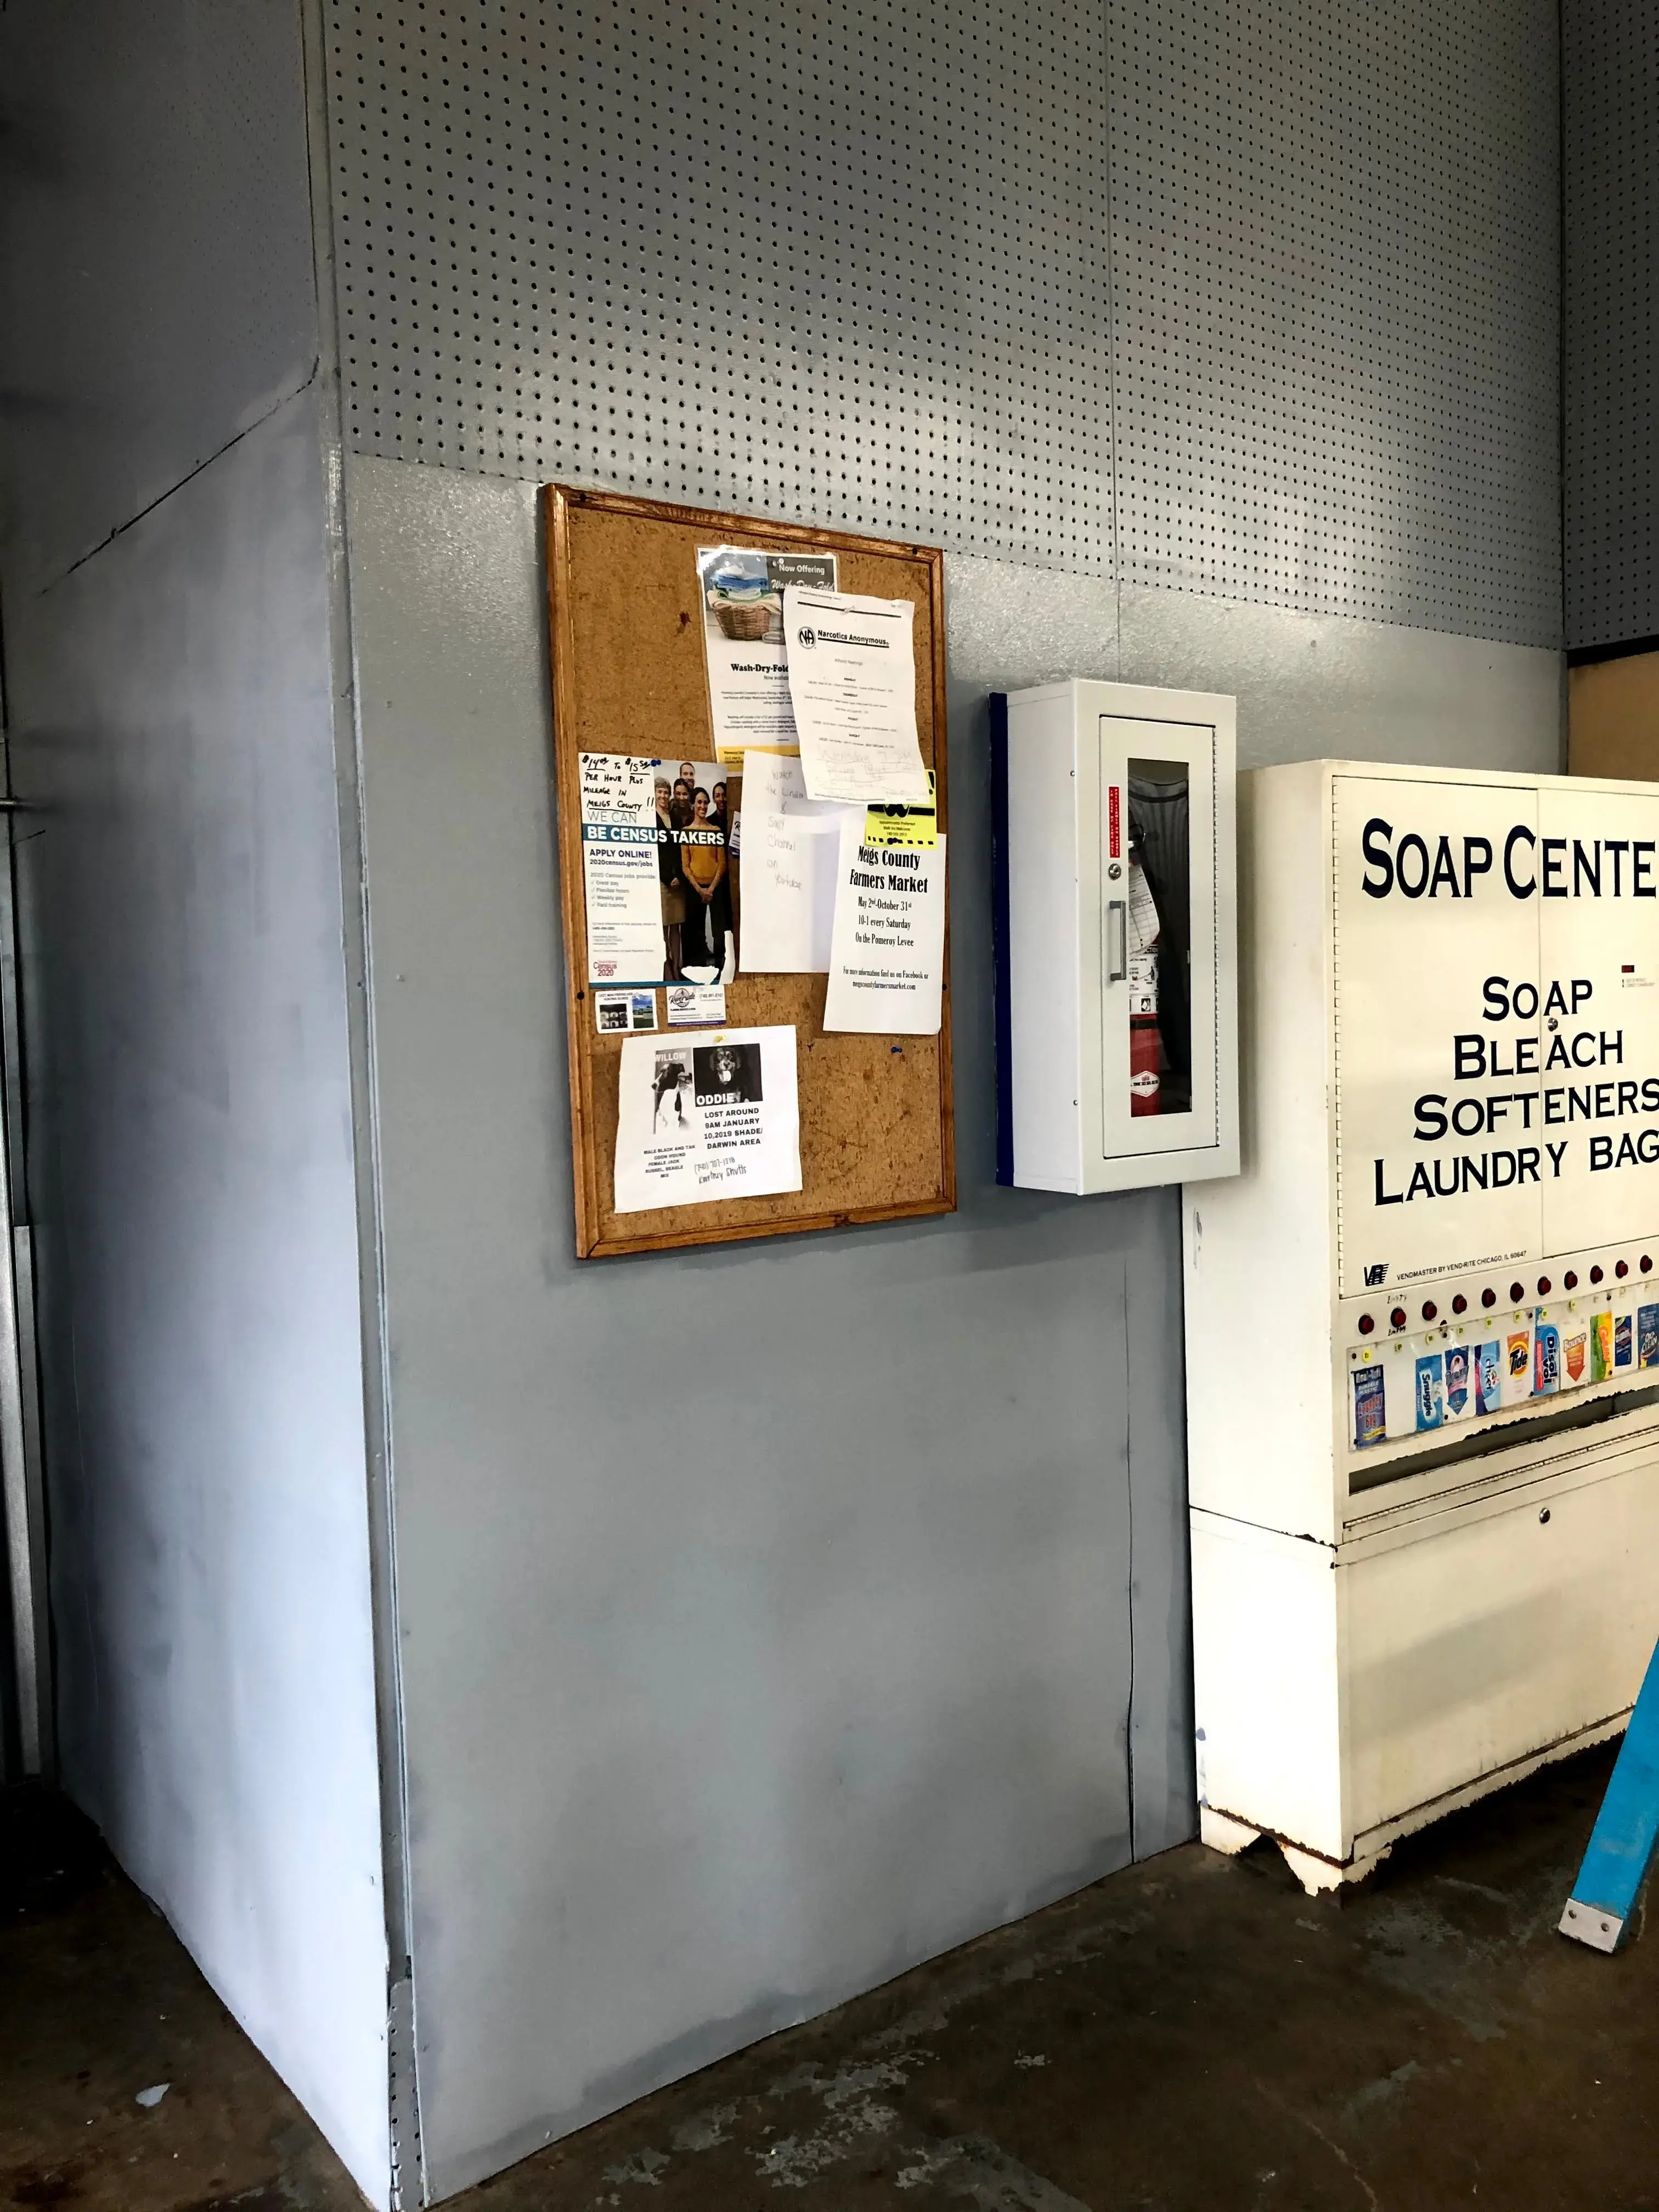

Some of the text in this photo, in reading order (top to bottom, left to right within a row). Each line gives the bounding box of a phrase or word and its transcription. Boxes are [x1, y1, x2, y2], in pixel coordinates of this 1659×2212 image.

[797, 565, 825, 575] Offering
[818, 630, 847, 640] Narcotics
[585, 772, 598, 783] PER
[588, 811, 637, 823] WE CAN
[587, 826, 725, 845] BE CENSUS TAKERS
[590, 849, 652, 859] APPLY ONLINE!
[857, 845, 921, 870] Meigs County
[590, 859, 653, 867] 2020census.gov/jobs
[850, 869, 928, 893] Farmers Market
[858, 896, 867, 909] May
[900, 901, 912, 911] 31st
[858, 915, 911, 930] 10-1 every Saturday
[855, 932, 862, 943] On
[871, 934, 895, 947] Pomeroy
[898, 936, 914, 946] Levee
[859, 968, 879, 977] information
[902, 970, 923, 979] Facebook
[656, 1052, 686, 1062] WILLOW
[726, 1108, 759, 1116] AROUND
[723, 1118, 760, 1126] JANUARY
[704, 1127, 763, 1139] 10,2019 SHADE/
[707, 1141, 737, 1149] DARWIN
[1397, 1267, 1437, 1280] VENDMASTER
[1447, 1260, 1476, 1271] VEND-RITE
[1510, 1250, 1527, 1259] 60647
[1564, 1333, 1586, 1352] Bounce
[1510, 1348, 1528, 1375] Tide
[1446, 1365, 1470, 1386] Downy
[1421, 1373, 1433, 1417] Snuggle
